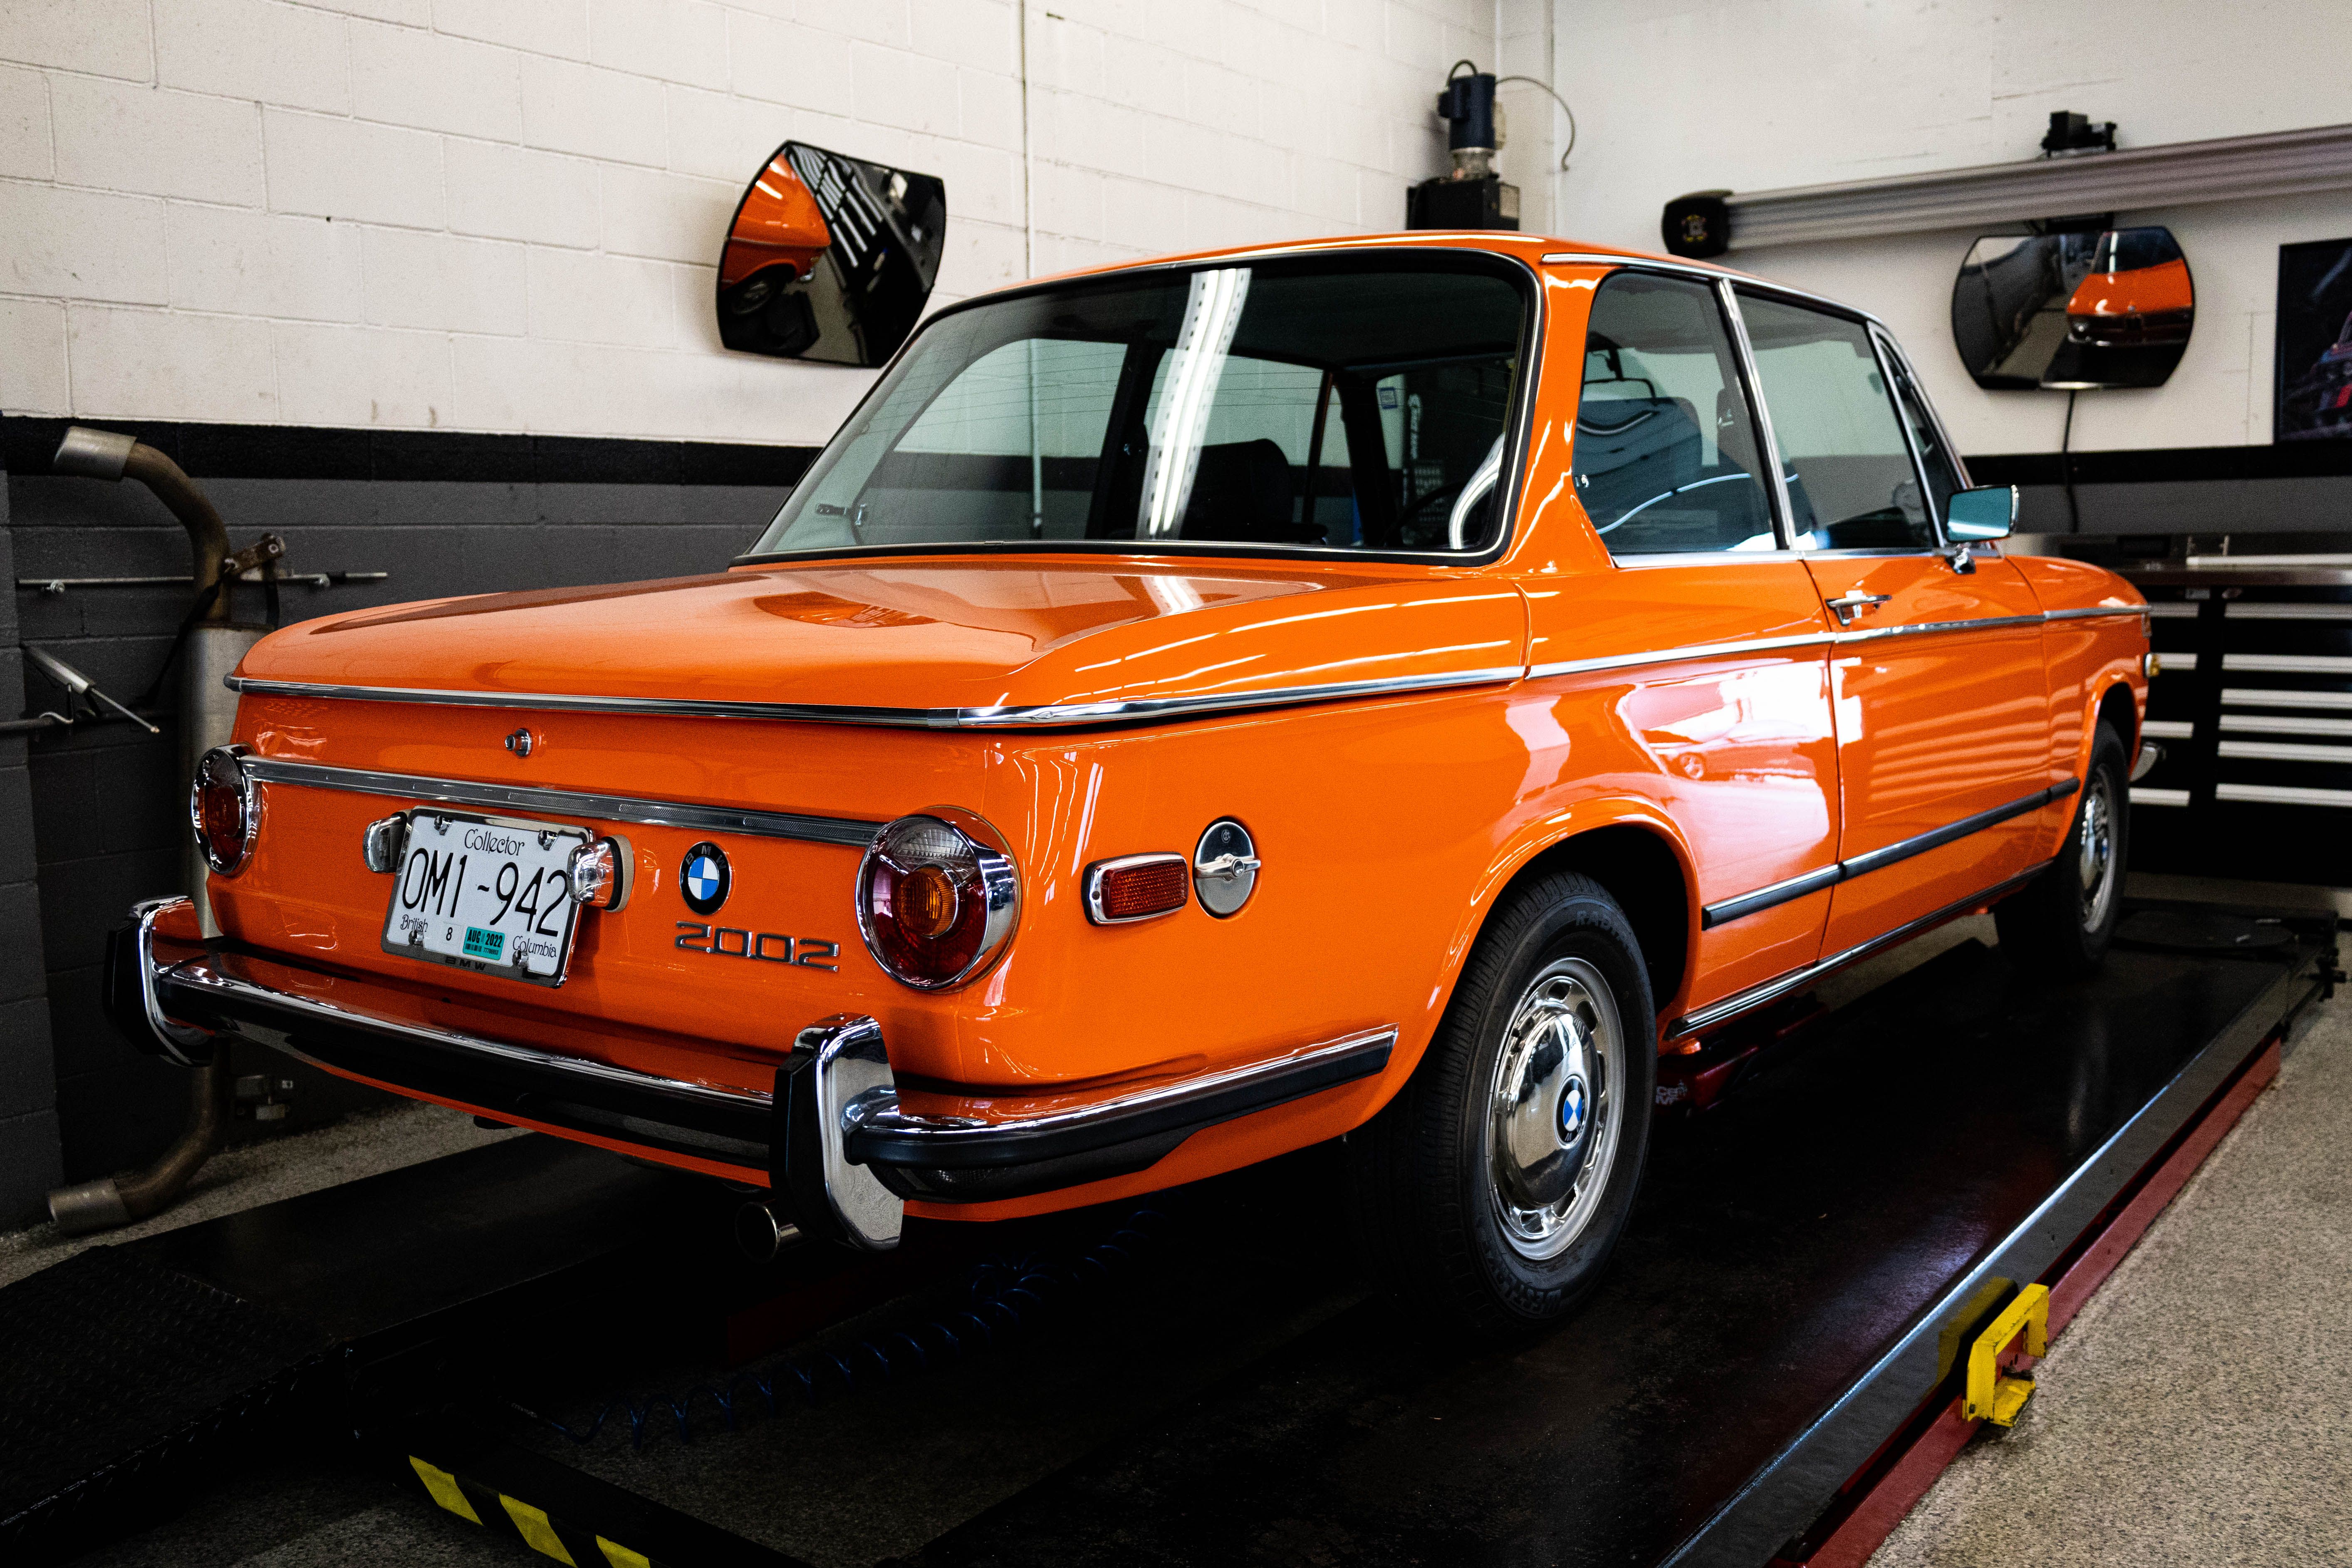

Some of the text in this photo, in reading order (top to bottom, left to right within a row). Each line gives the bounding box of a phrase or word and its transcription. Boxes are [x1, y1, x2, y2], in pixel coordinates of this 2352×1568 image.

[464, 828, 525, 856] Collector
[686, 845, 727, 870] BMW
[400, 914, 428, 932] British
[446, 927, 453, 941] 8
[467, 929, 503, 948] AUG 2022
[512, 936, 557, 958] Columbia
[675, 921, 840, 972] 2002
[445, 956, 486, 971] BMW
